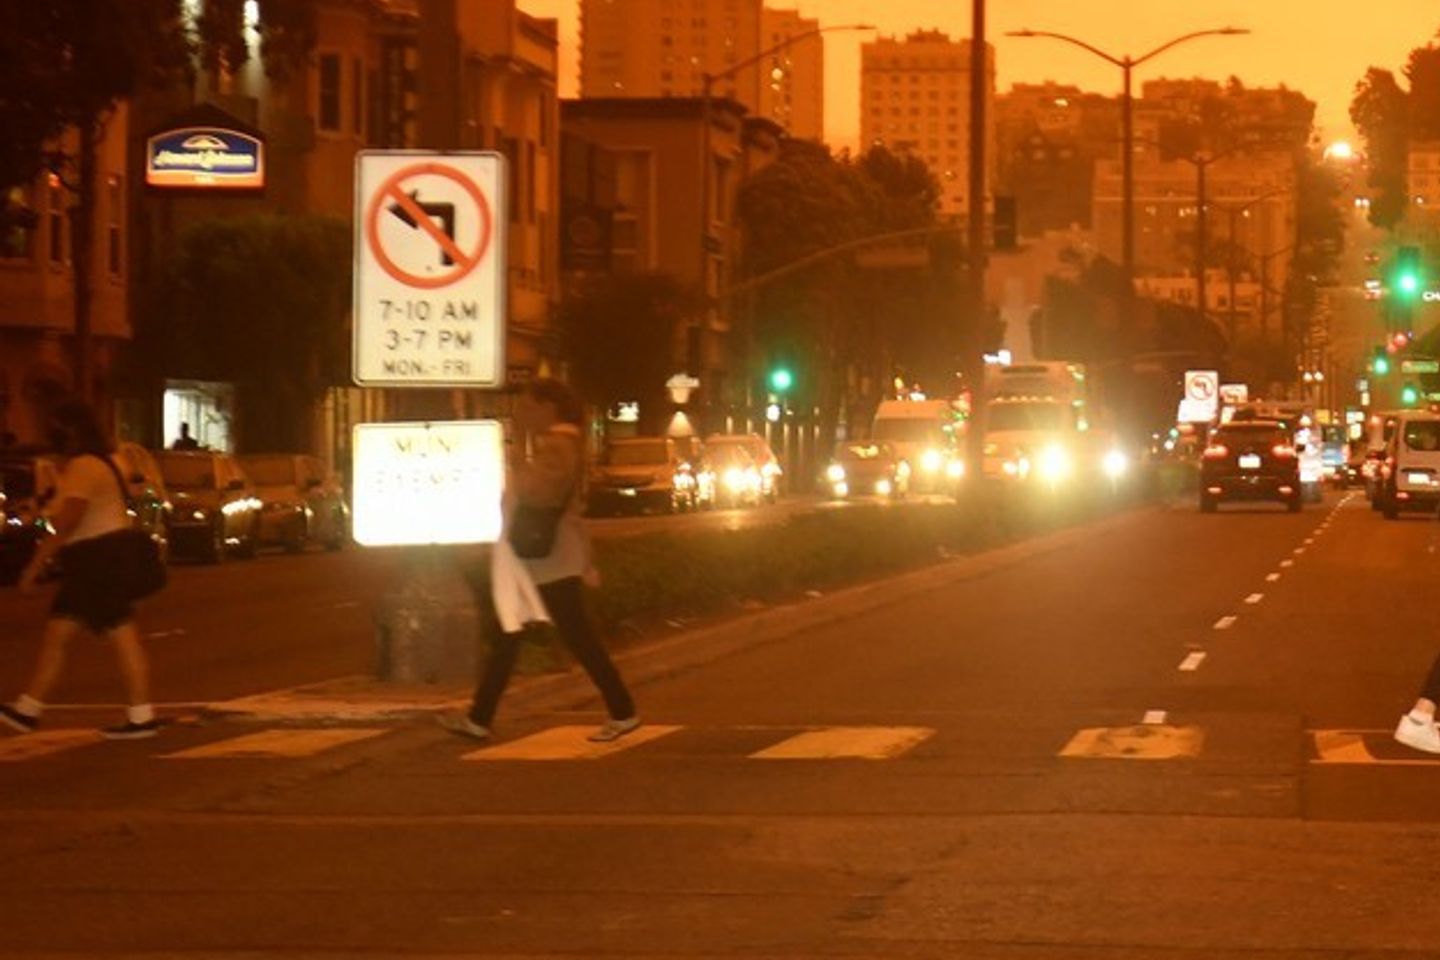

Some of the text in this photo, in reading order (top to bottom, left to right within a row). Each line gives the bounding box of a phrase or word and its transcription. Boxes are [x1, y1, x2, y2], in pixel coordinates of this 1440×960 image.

[379, 300, 478, 321] 7-10 AM
[386, 329, 472, 350] 3-7 PM
